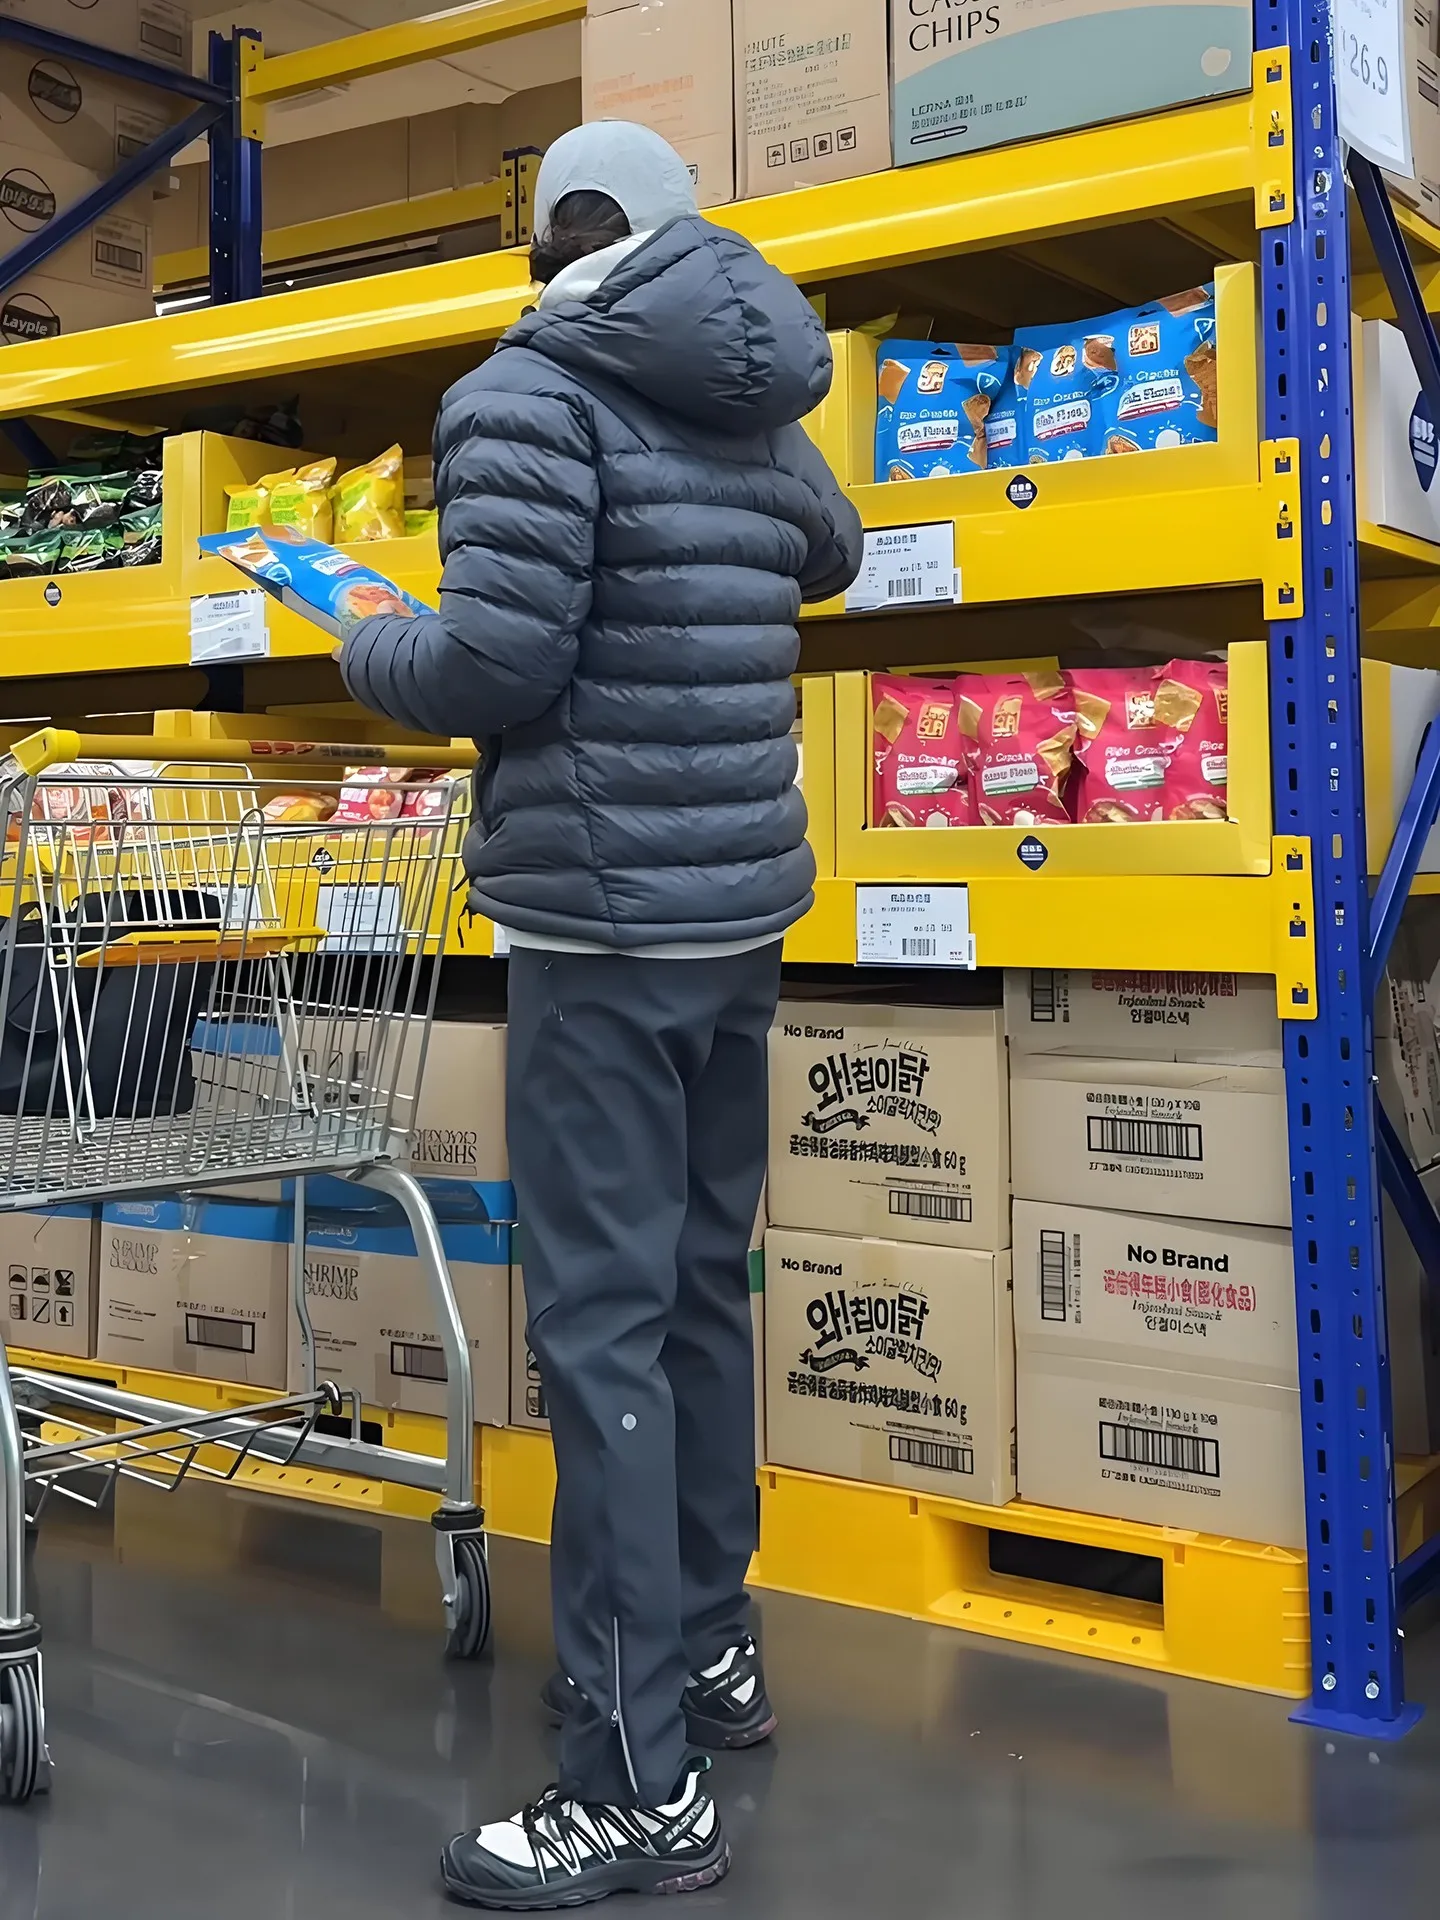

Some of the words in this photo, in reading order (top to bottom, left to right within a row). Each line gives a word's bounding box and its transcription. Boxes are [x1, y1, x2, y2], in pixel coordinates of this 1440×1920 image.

[908, 5, 1001, 52] CHIPS
[783, 1024, 801, 1038] No
[804, 1026, 845, 1041] Brand
[781, 1257, 800, 1271] No
[802, 1260, 843, 1276] Brand
[1127, 1243, 1158, 1265] No
[1162, 1248, 1230, 1273] Brand
